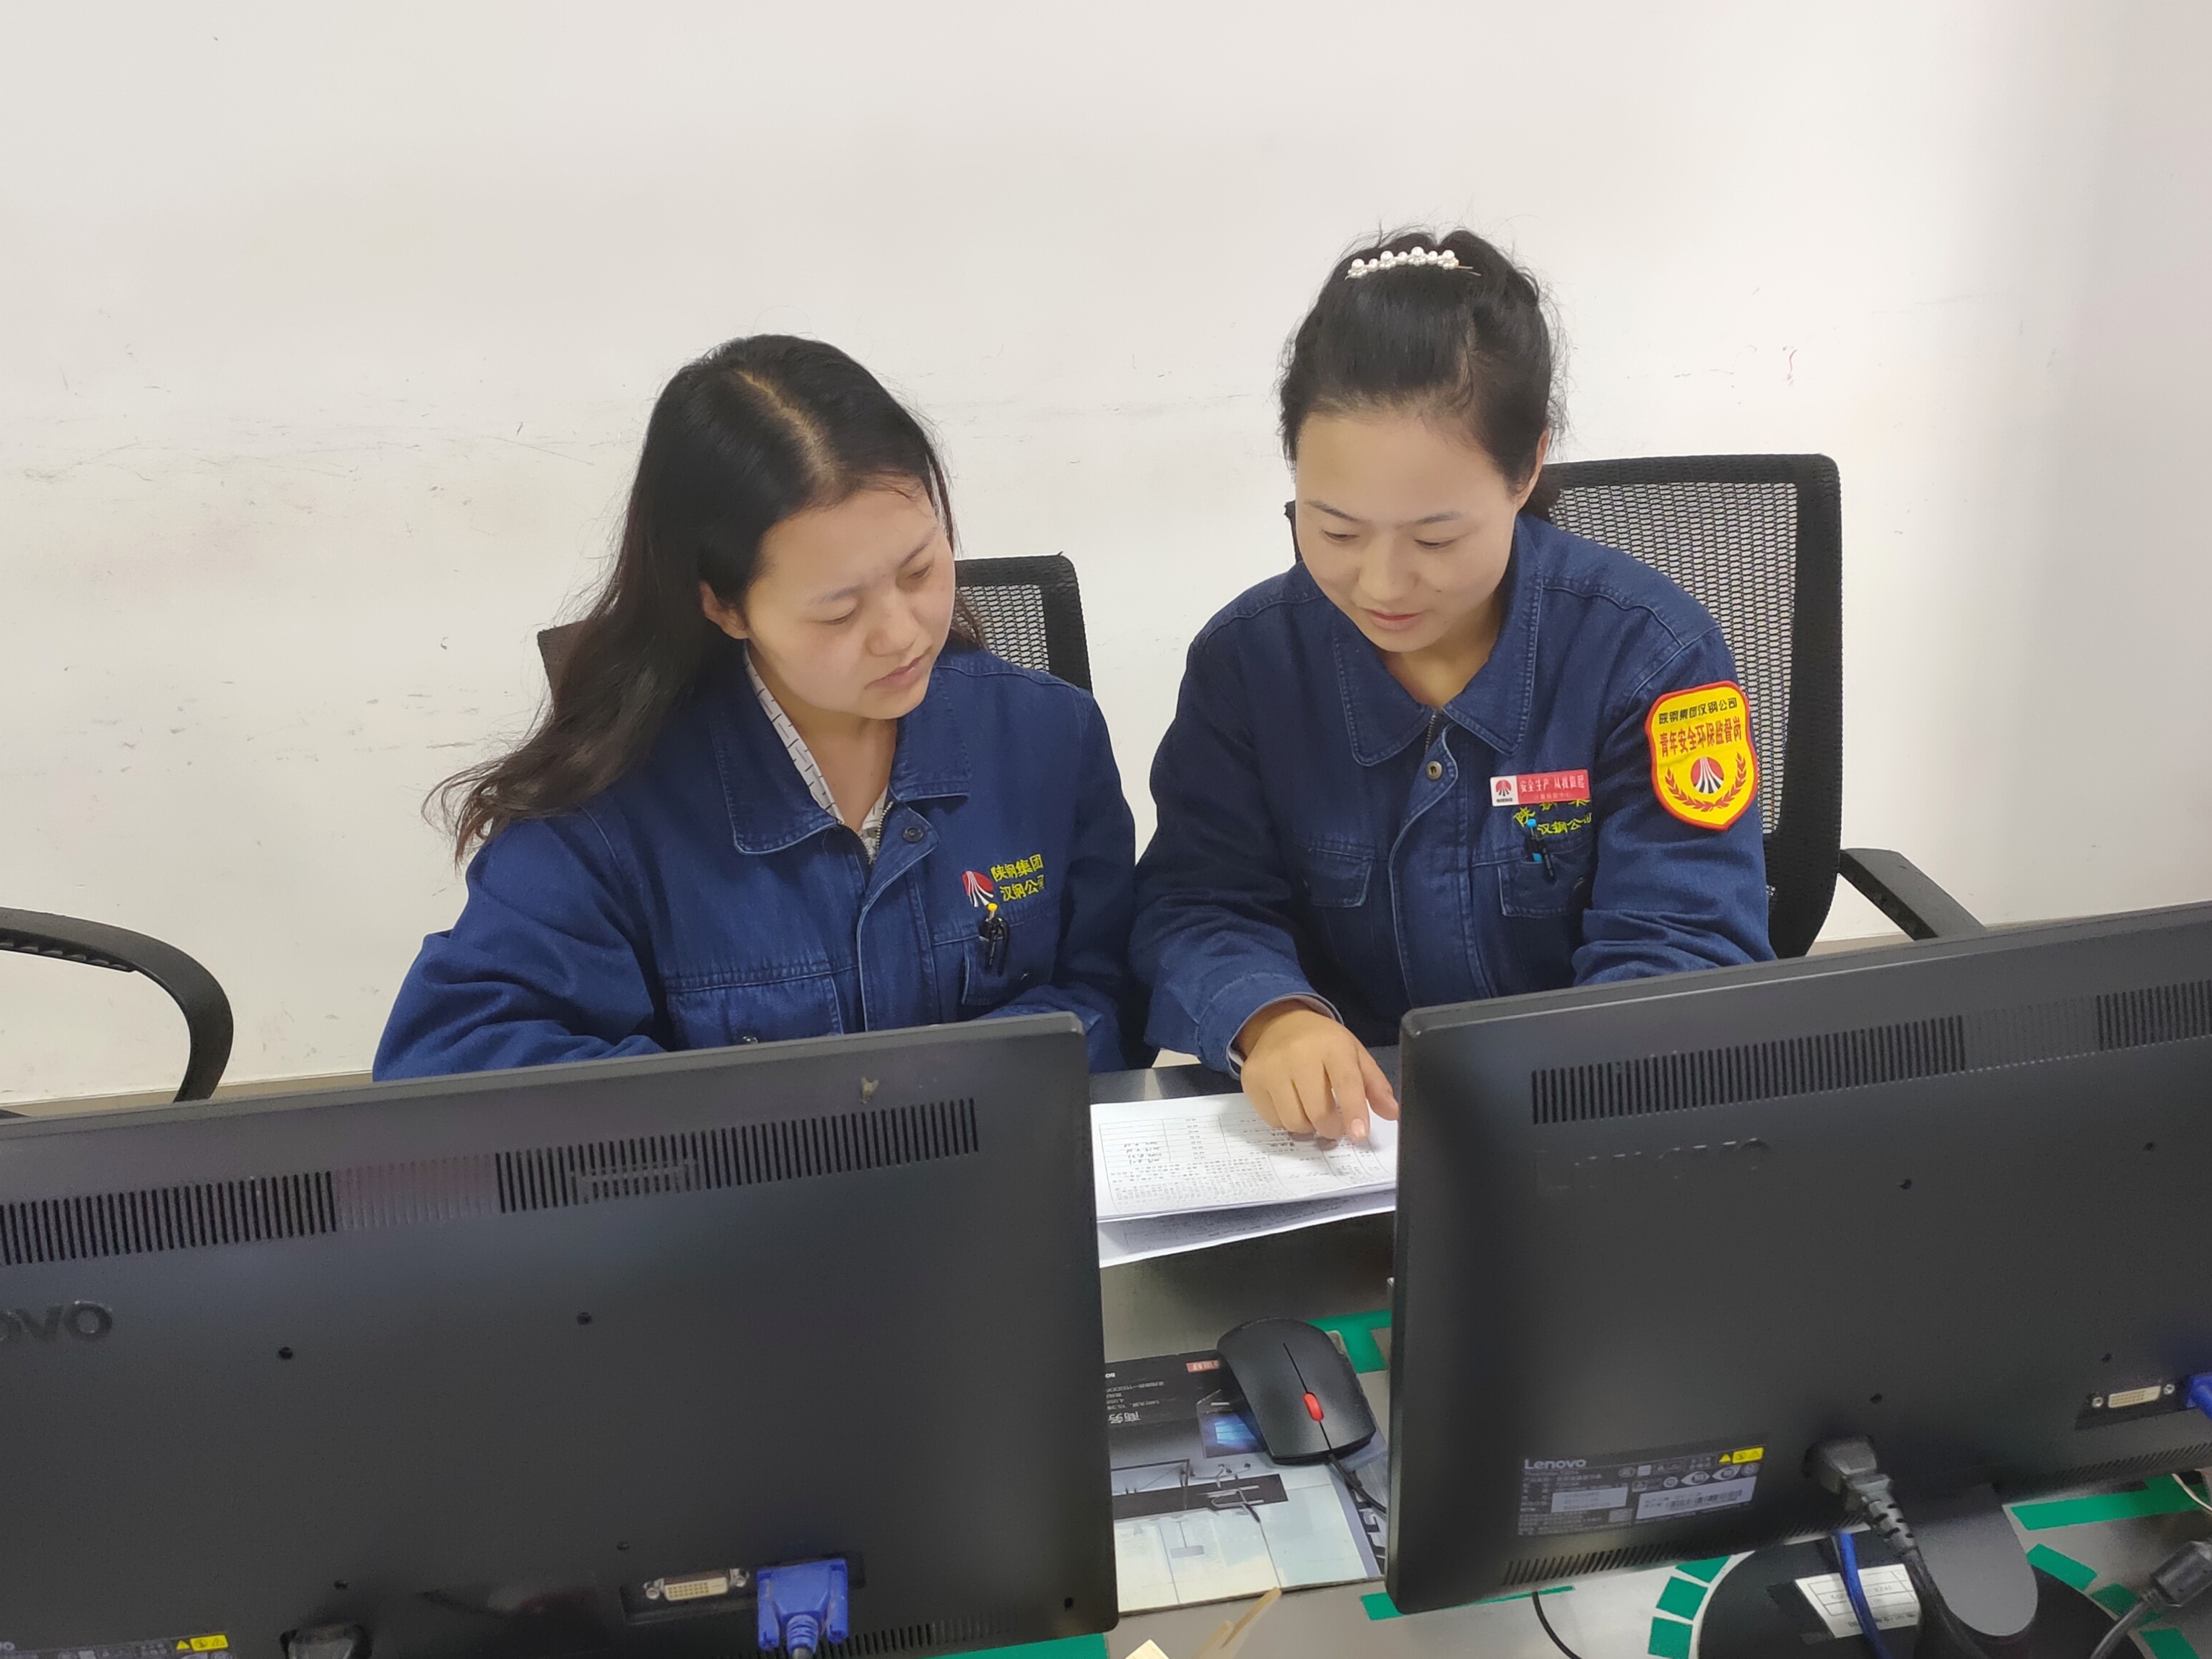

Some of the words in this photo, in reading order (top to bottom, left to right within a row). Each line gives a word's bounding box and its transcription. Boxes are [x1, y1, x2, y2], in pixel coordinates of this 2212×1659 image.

[1658, 697, 1738, 724] 陕钢集团汉钢公司
[1660, 715, 1742, 757] 青年安全环保监督岗
[1520, 778, 1550, 793] 安全生产
[990, 853, 1045, 882] 陕钢集团
[1524, 1458, 1587, 1470] Lenovo
